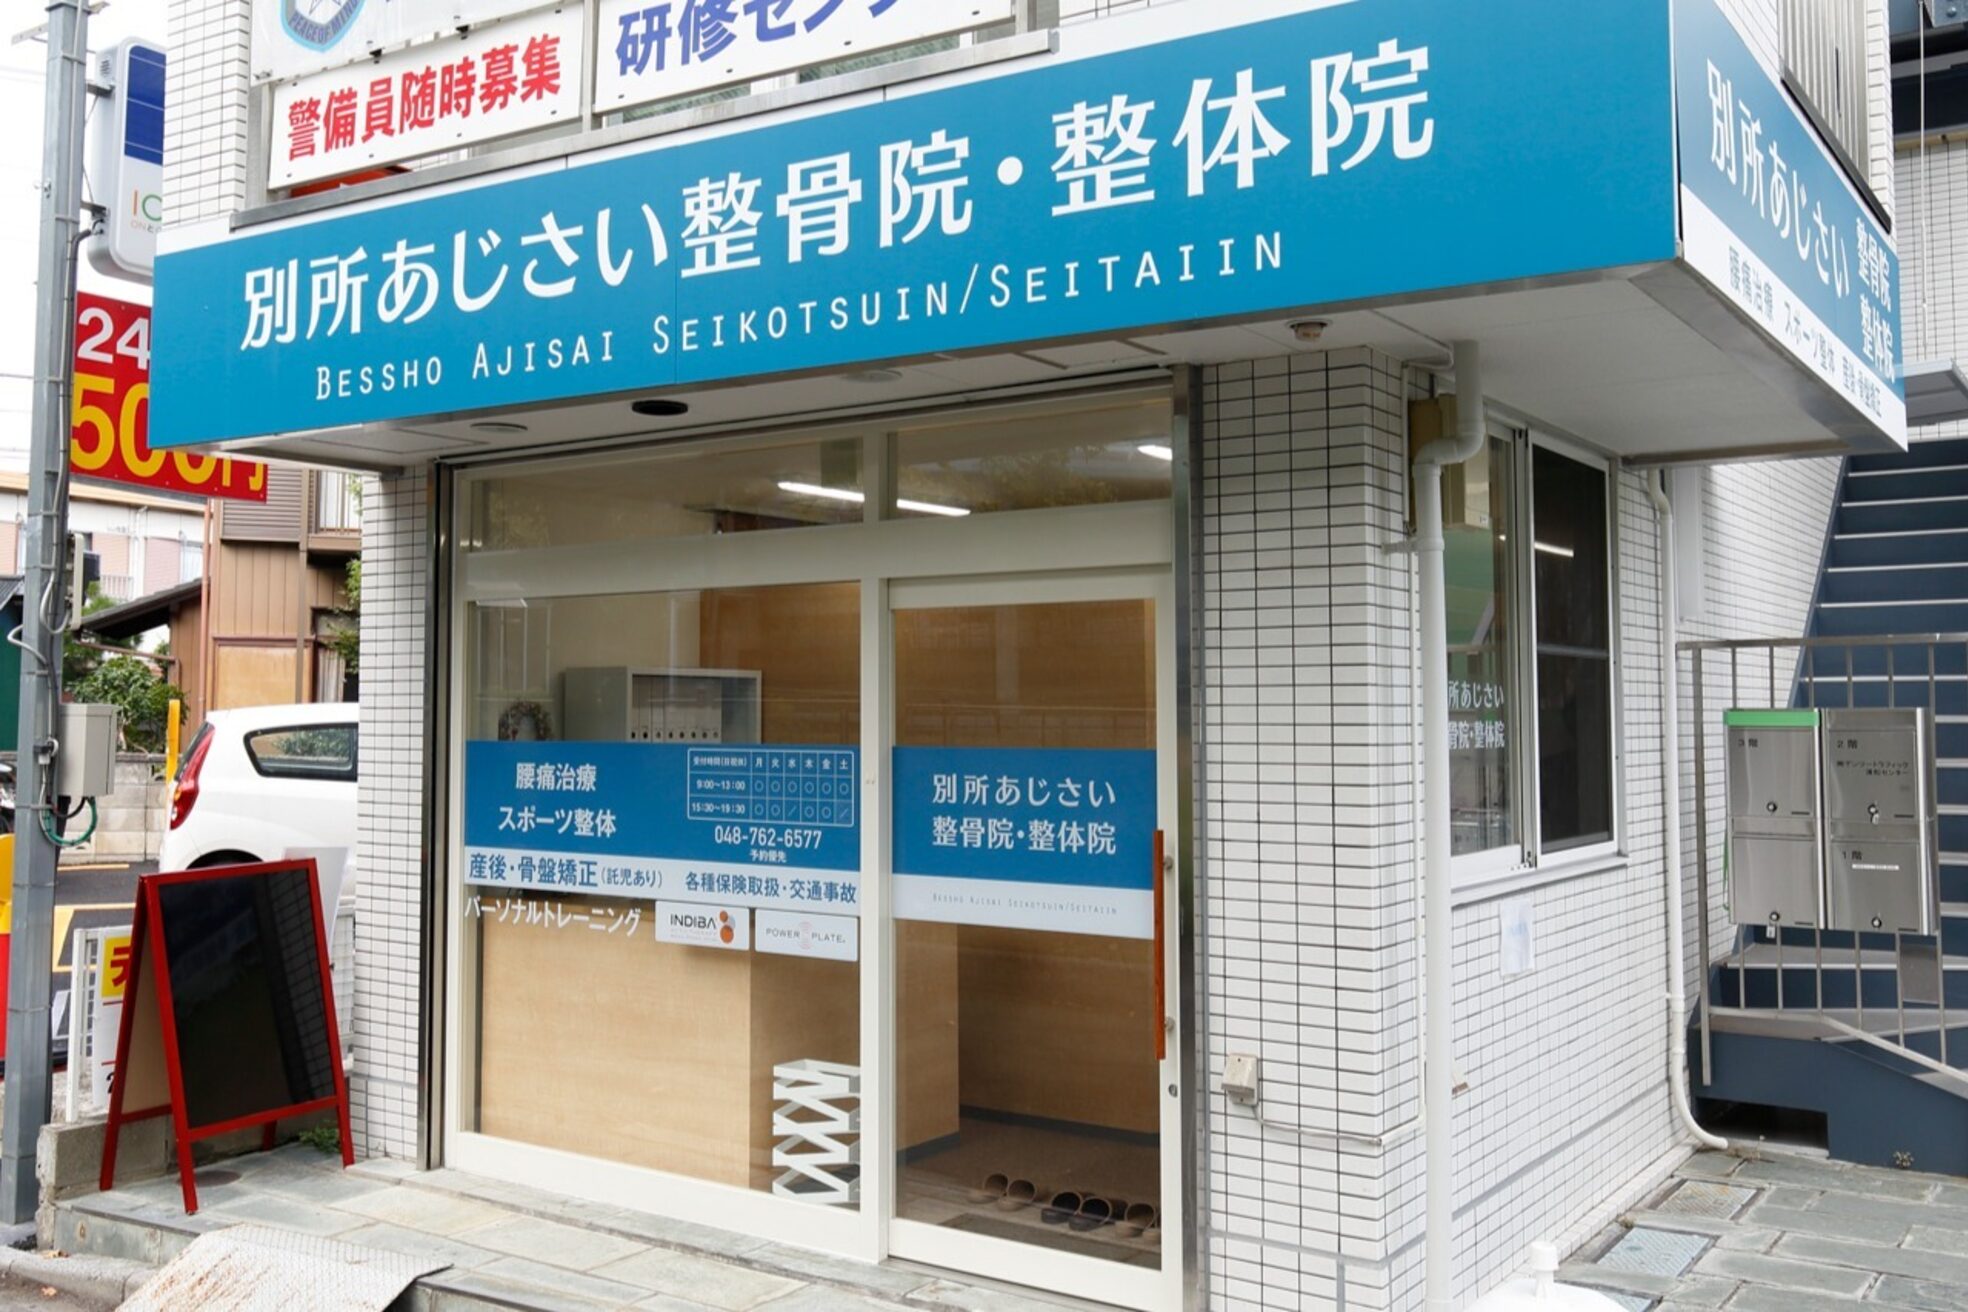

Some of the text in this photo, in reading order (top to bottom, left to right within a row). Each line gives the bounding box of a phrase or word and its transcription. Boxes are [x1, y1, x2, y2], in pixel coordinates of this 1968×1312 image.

[616, 0, 898, 77] 研修セ
[287, 33, 562, 162] 警備員随時募集
[239, 37, 1435, 352] 別所あじさい整骨院・整体院
[1707, 57, 1850, 299] 別所あじさい
[315, 230, 1283, 401] BESSHO AJISAI SEIKOTSUIN/SEITAIIN
[515, 761, 597, 793] 腰痛治療
[755, 758, 763, 768] 月
[771, 758, 780, 768] 火
[787, 758, 797, 769] 水
[804, 758, 814, 769] 木
[821, 758, 831, 770] 金
[839, 758, 849, 770] 土
[931, 773, 1117, 808] 別所あじさい
[498, 805, 617, 839] スポーツ整体
[714, 824, 823, 850] 048-762-6577
[931, 815, 1117, 856] 整骨院・整体院
[685, 871, 857, 904] 各種保険取扱・交通事故
[464, 895, 642, 937] パーソナルトレーニング
[670, 913, 717, 931] INDIBA
[765, 927, 801, 938] POWER
